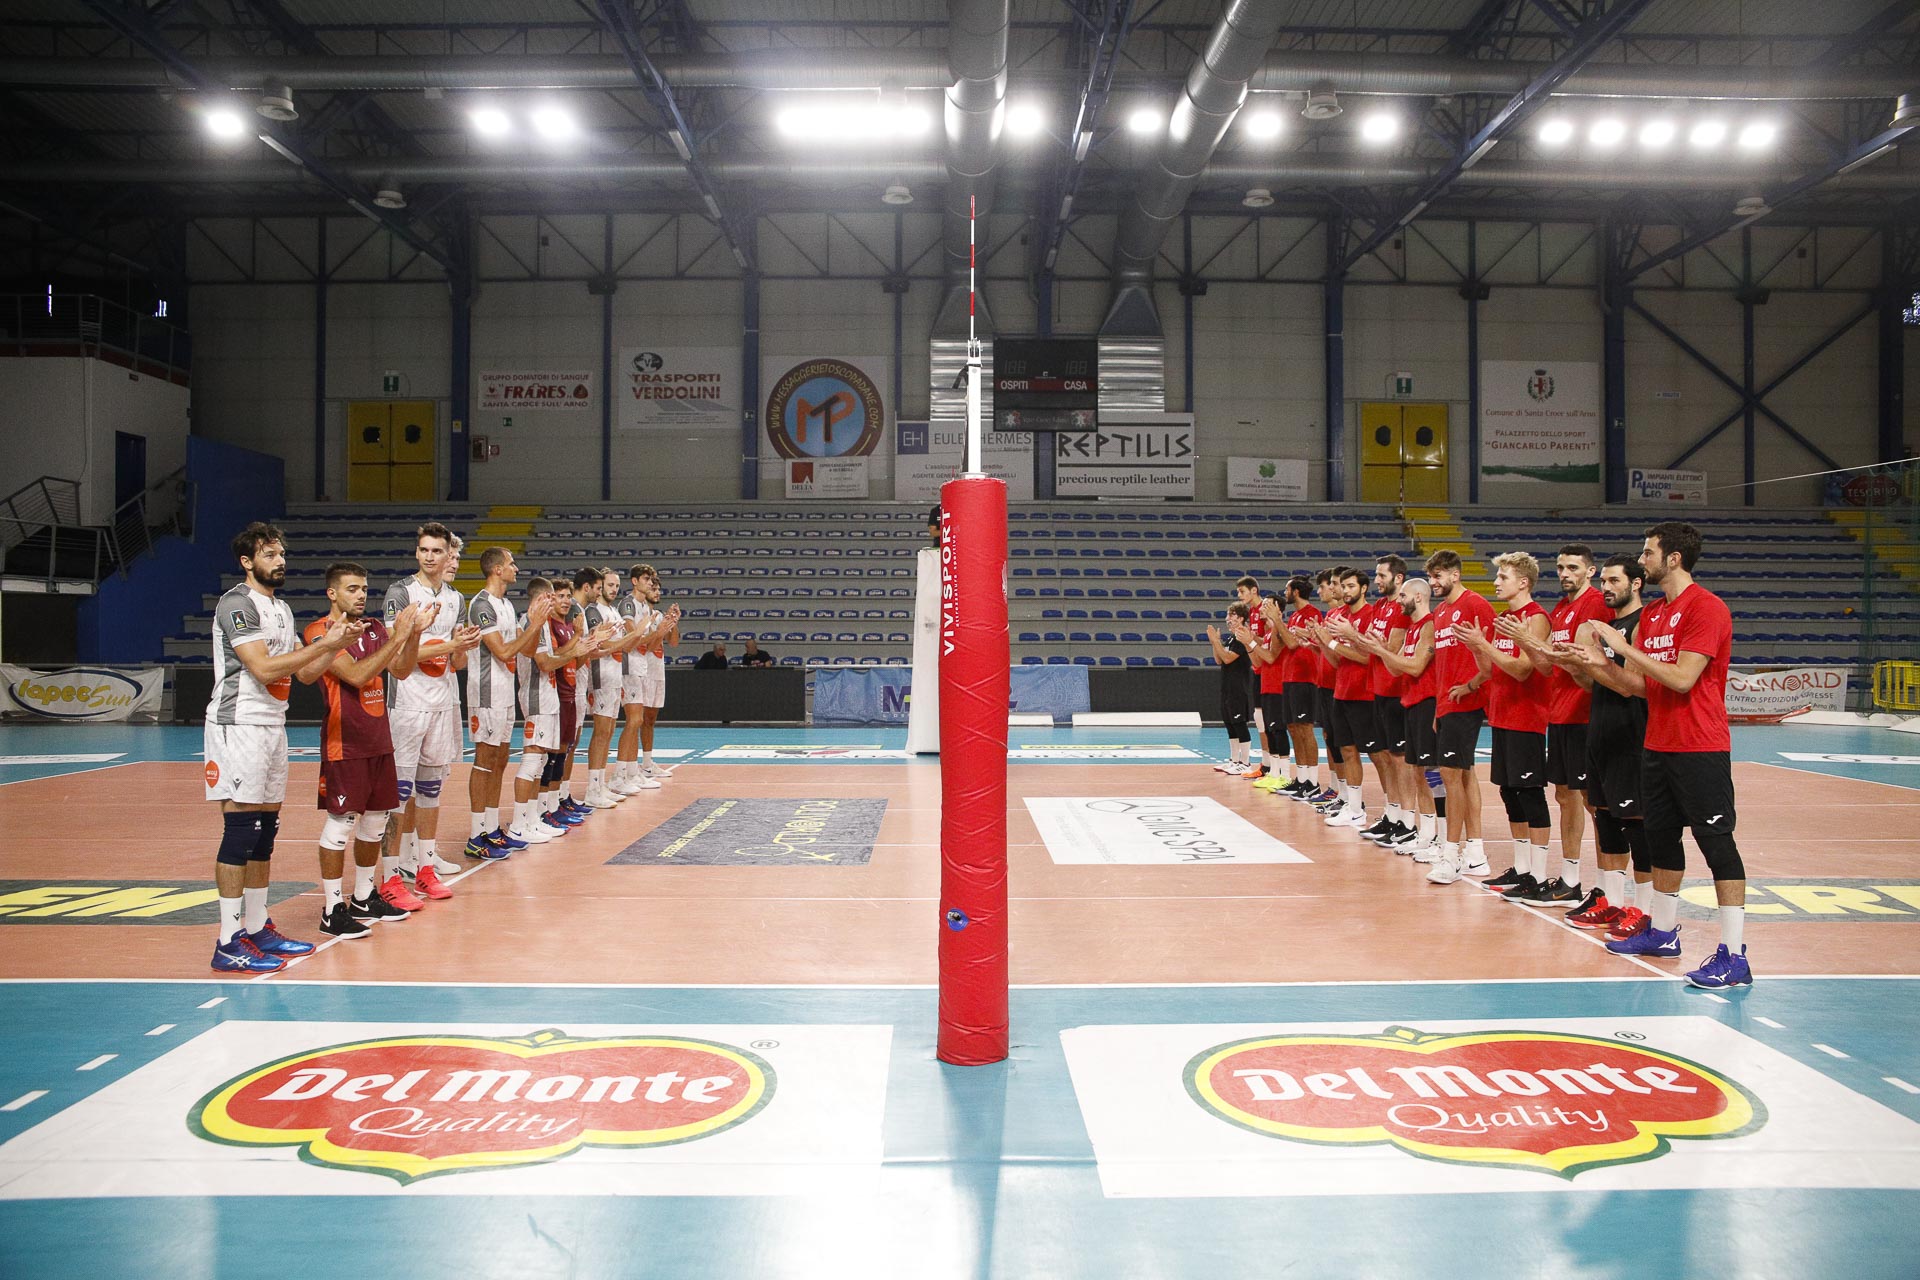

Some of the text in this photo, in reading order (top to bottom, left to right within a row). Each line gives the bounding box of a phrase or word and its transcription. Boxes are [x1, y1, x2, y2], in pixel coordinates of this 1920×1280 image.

[632, 374, 721, 383] TRASPORTI
[1000, 380, 1029, 390] OSPITI
[1063, 380, 1088, 390] CASA
[632, 386, 721, 400] VERDOLINI
[1485, 408, 1515, 417] Comune
[1516, 408, 1524, 417] di
[1524, 408, 1544, 417] Santa
[1545, 409, 1564, 417] Croce
[934, 432, 964, 445] EULE
[1495, 430, 1540, 438] PALAZZETTO
[1058, 433, 1192, 457] REPTILIS
[1058, 474, 1191, 486] precious reptile leather
[942, 508, 955, 656] VIVISPORT
[1726, 694, 1757, 703] CENTRO
[1162, 840, 1236, 862] SPA
[258, 1068, 430, 1102] Del
[432, 1068, 735, 1103] Monte
[1233, 1066, 1395, 1101] Del
[1392, 1062, 1698, 1099] Monte
[349, 1106, 580, 1140] Quality
[1385, 1102, 1610, 1135] Quality
